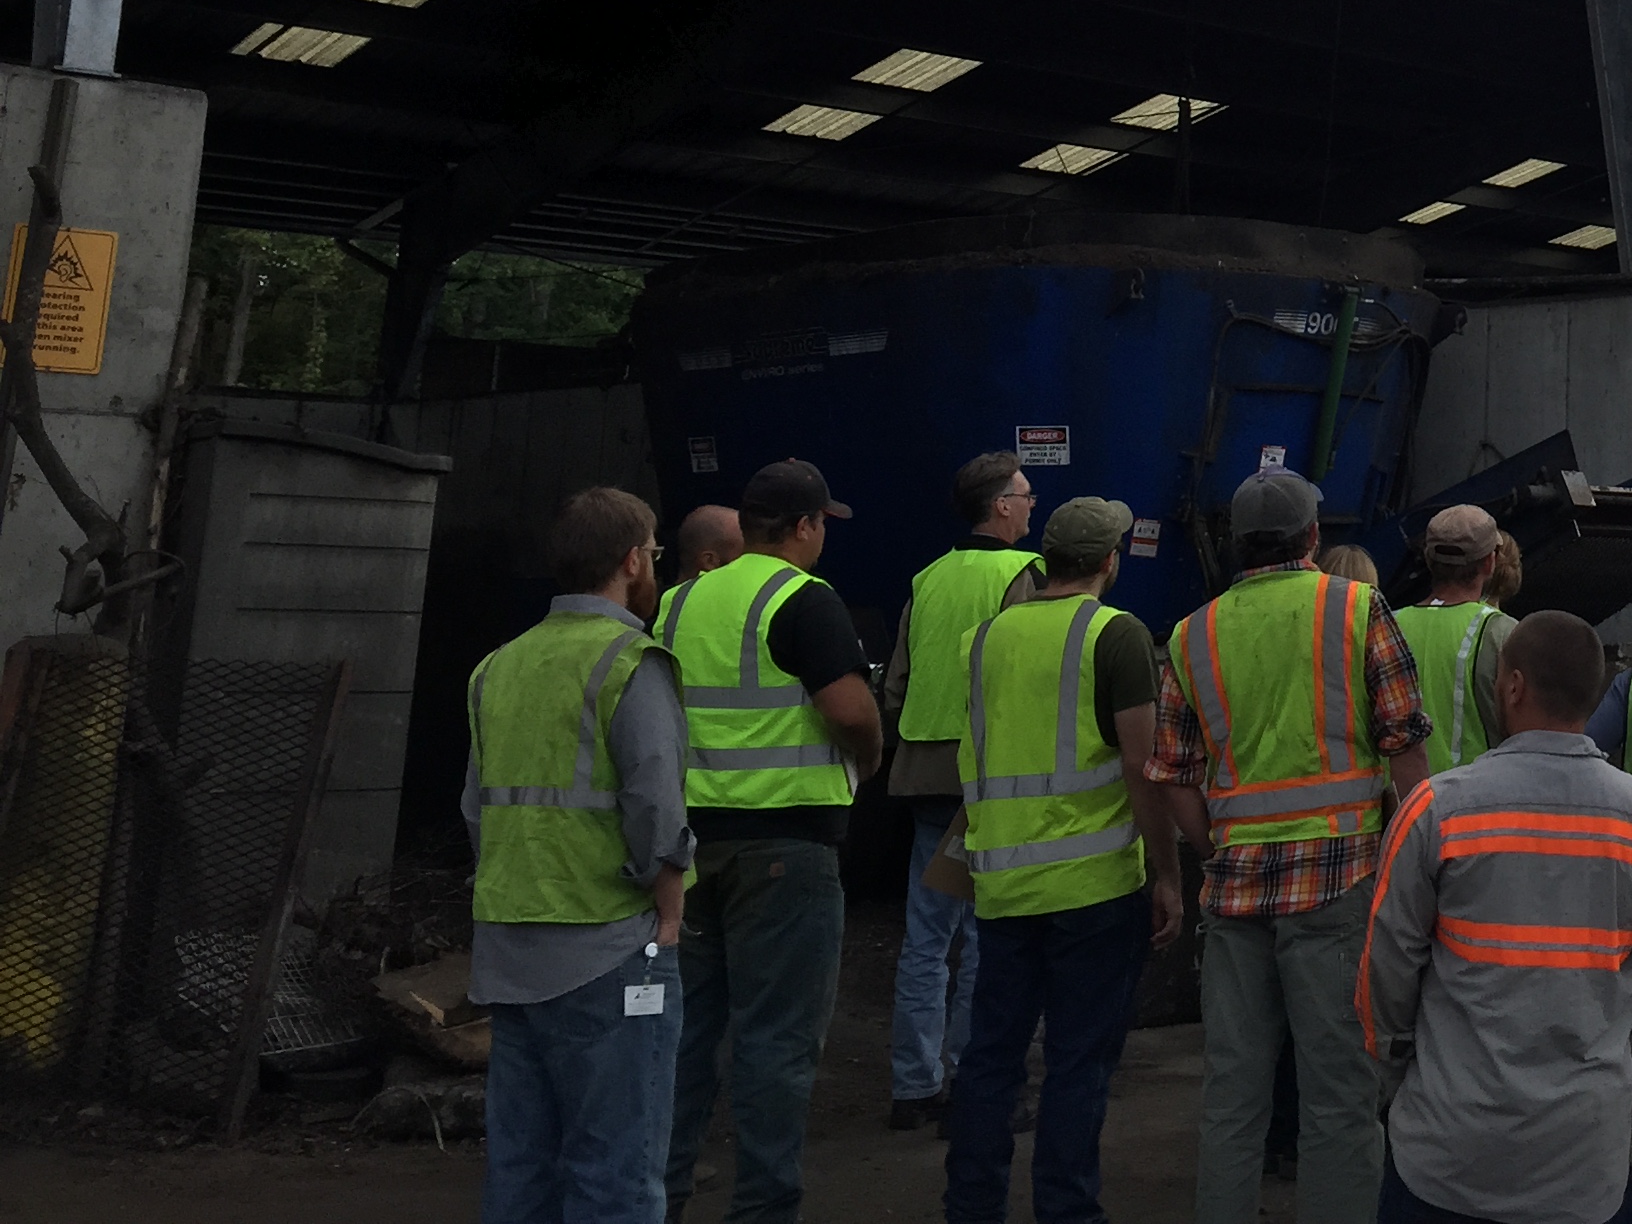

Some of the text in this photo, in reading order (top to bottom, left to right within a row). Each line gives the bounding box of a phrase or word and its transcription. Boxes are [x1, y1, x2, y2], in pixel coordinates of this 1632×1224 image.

[40, 302, 86, 312] otection
[39, 312, 79, 322] quired
[36, 320, 84, 333] this area
[34, 333, 84, 343] en mixer
[1027, 431, 1058, 440] DANGER
